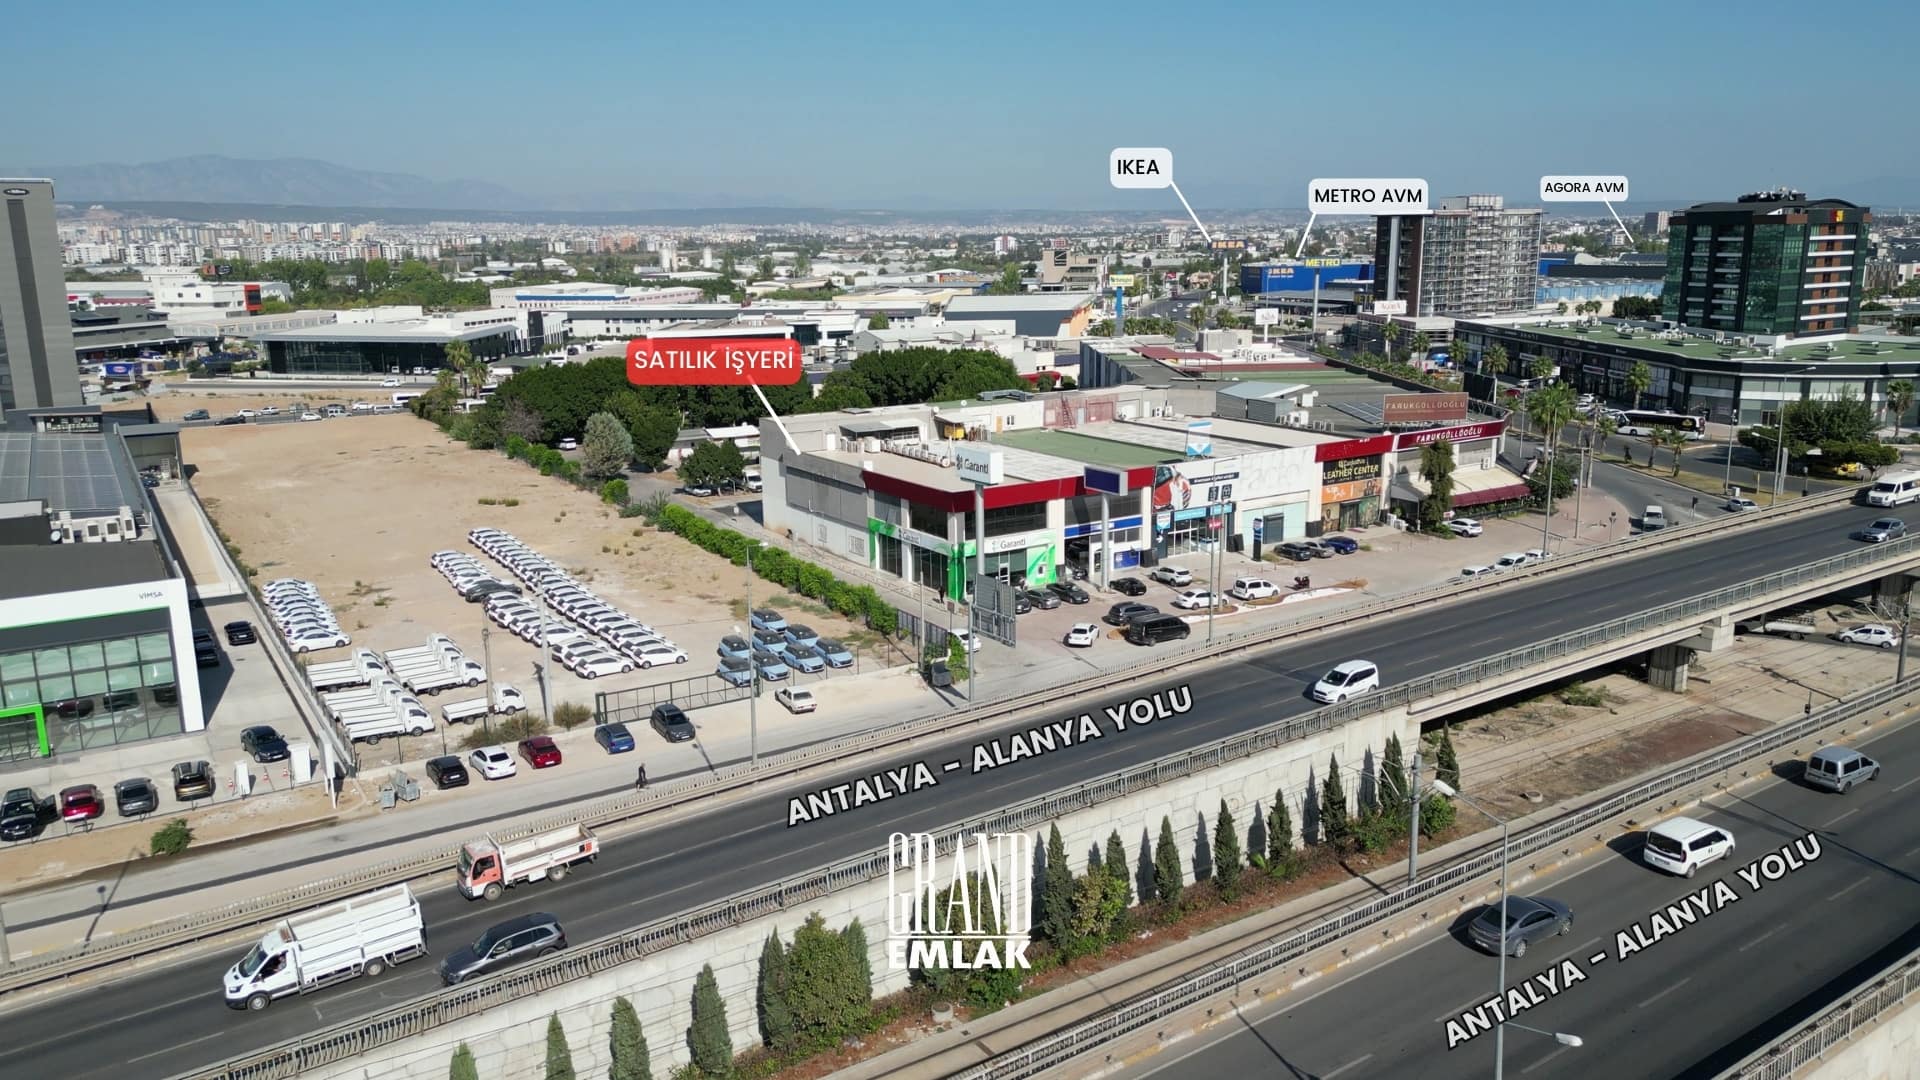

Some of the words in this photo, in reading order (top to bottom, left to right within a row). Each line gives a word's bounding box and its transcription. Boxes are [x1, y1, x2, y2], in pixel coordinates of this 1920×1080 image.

[1211, 241, 1245, 249] IKEA
[1305, 258, 1341, 267] METRO
[1323, 468, 1352, 480] LEATHER
[1353, 464, 1379, 475] CENTER
[1000, 537, 1025, 549] Garanti
